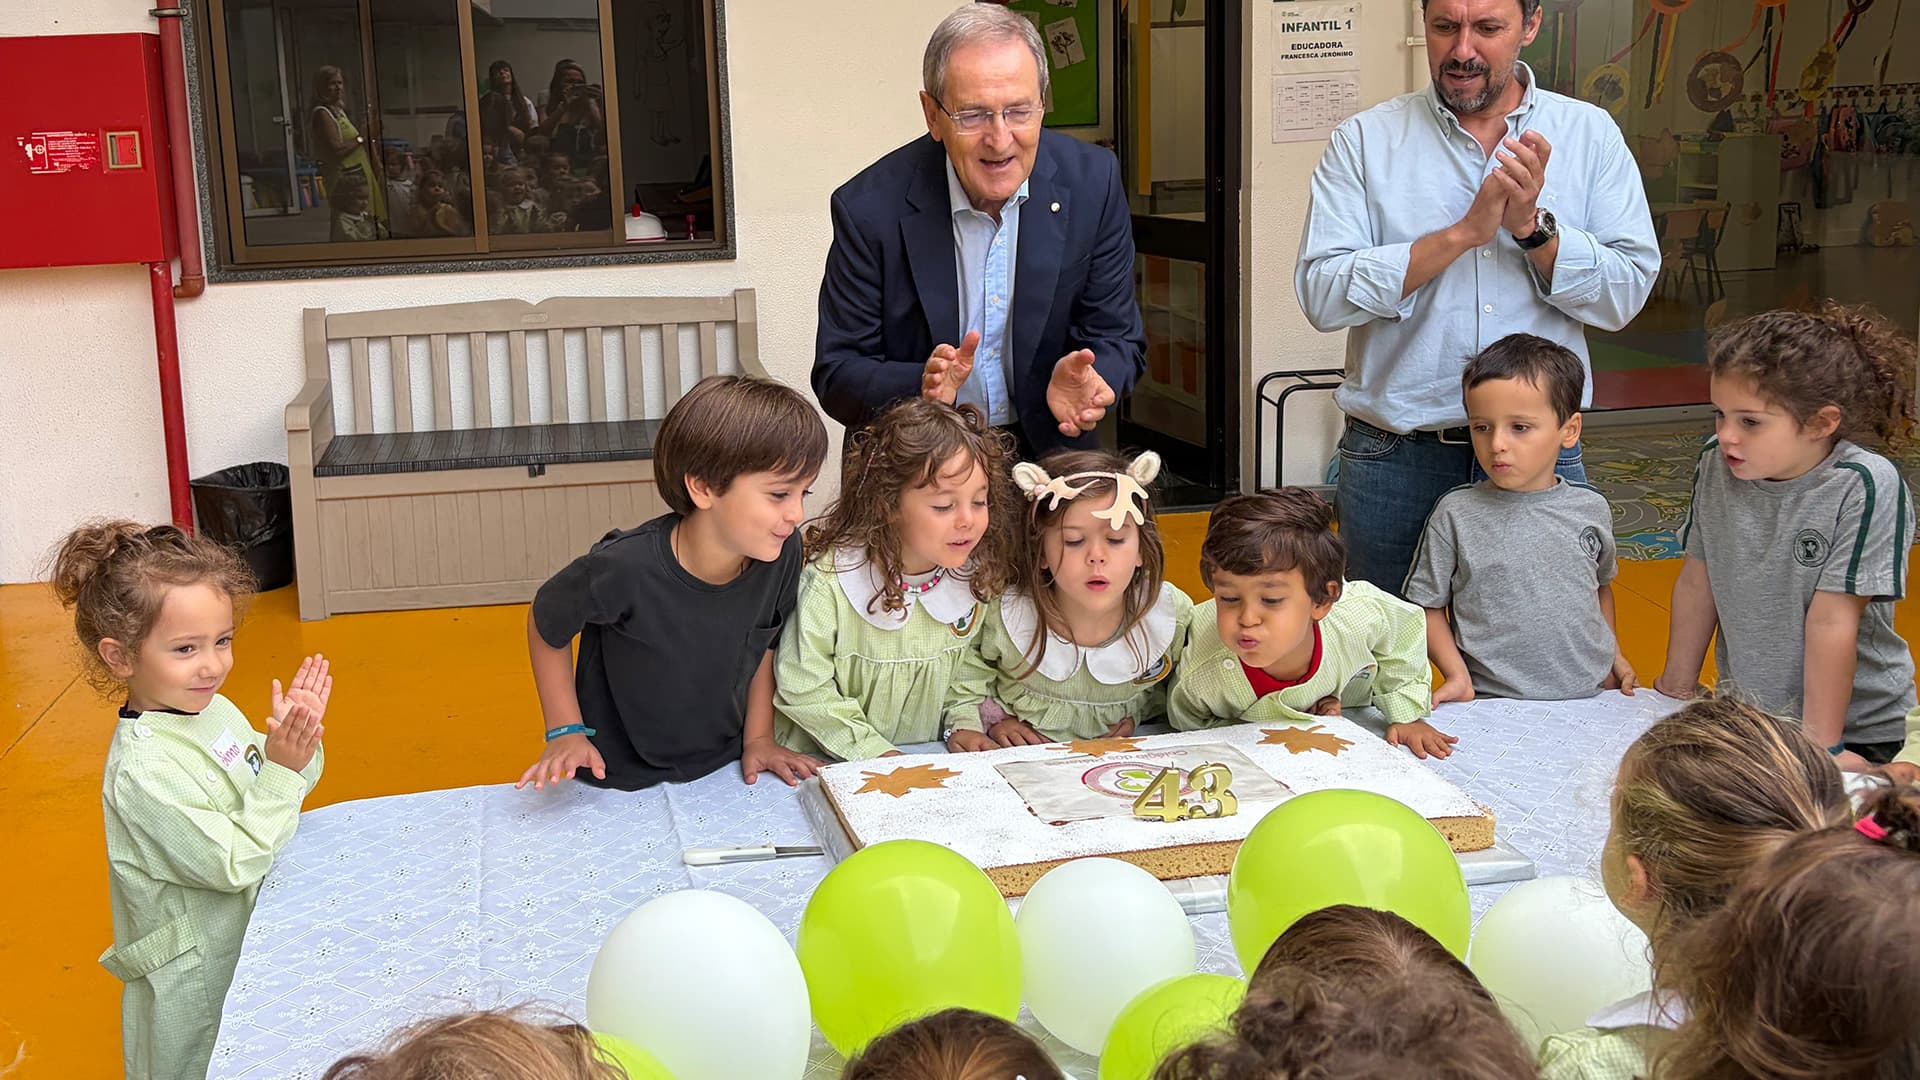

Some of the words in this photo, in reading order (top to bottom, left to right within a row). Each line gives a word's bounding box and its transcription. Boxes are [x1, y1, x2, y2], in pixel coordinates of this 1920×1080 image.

[1281, 20, 1341, 33] INFANTIL
[1345, 20, 1352, 30] 1
[1291, 41, 1343, 51] EDUCADORA
[1132, 762, 1238, 823] 43
